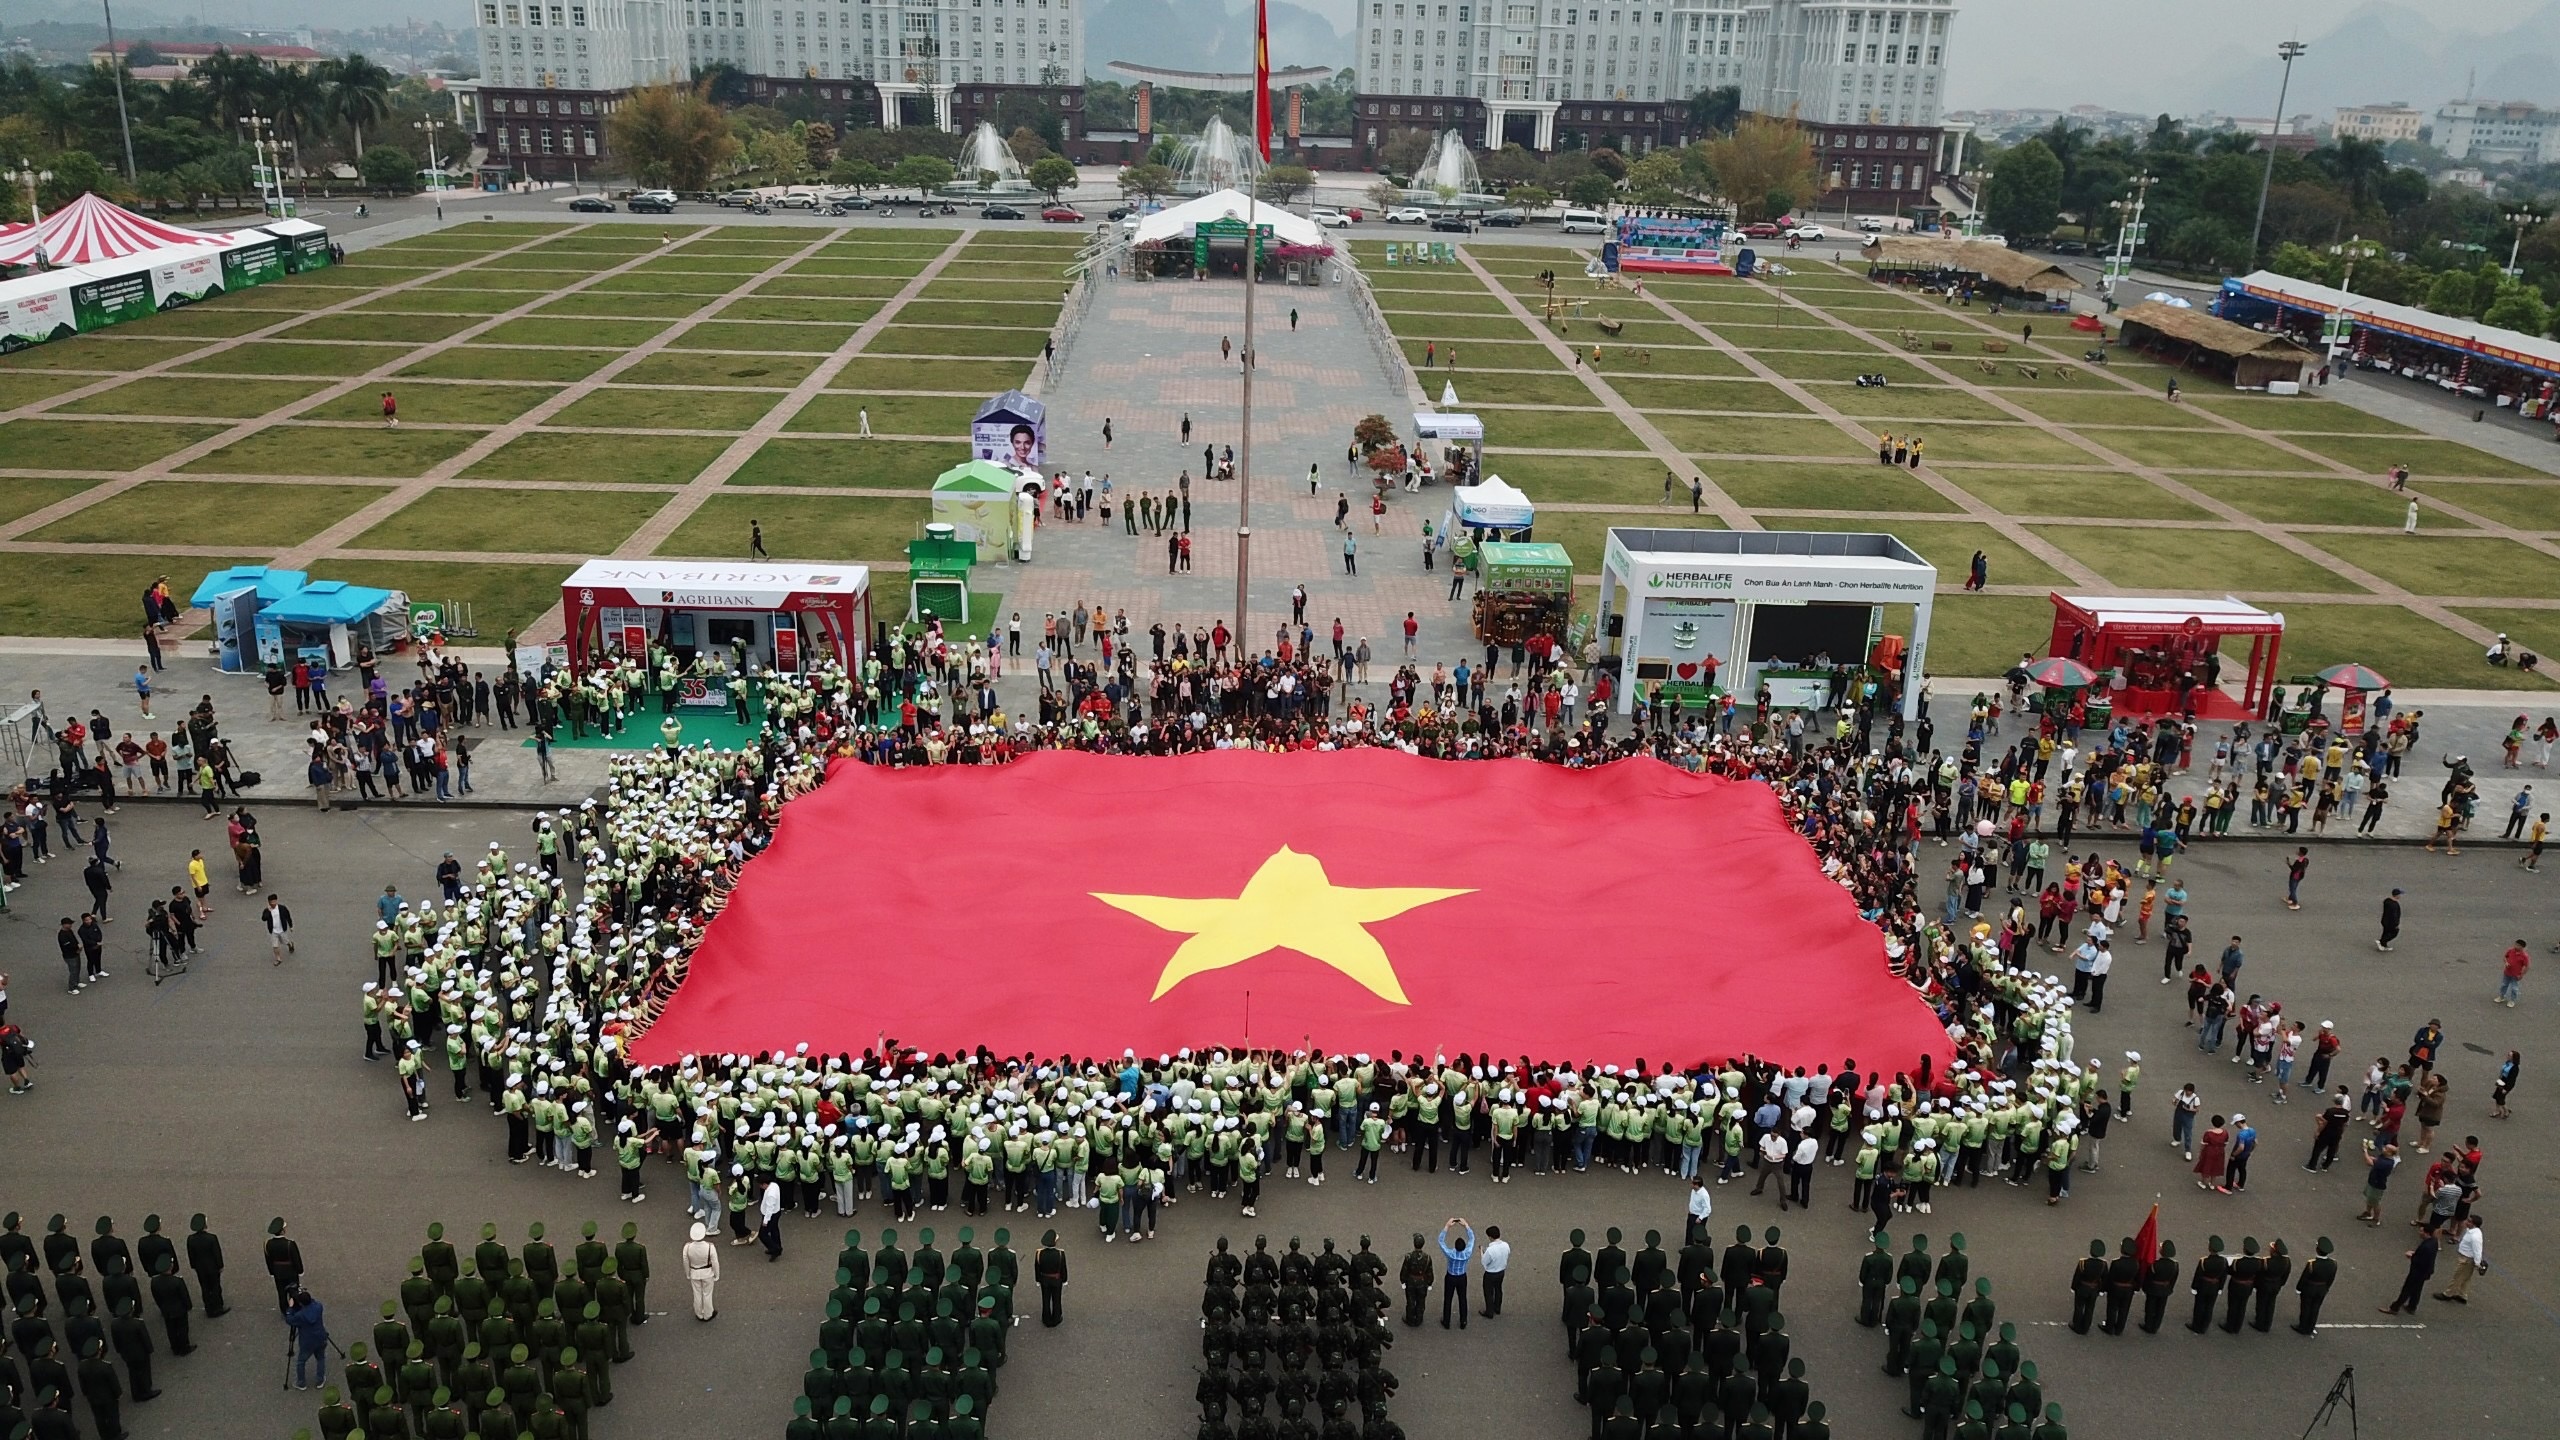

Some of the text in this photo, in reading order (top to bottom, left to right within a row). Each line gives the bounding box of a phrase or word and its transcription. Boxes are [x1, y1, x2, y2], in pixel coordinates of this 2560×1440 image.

[600, 570, 803, 583] AGRIBANK
[1666, 573, 1733, 581] HERBALIFE
[1666, 581, 1732, 589] NUTRITION
[677, 595, 754, 606] AGRIBANK
